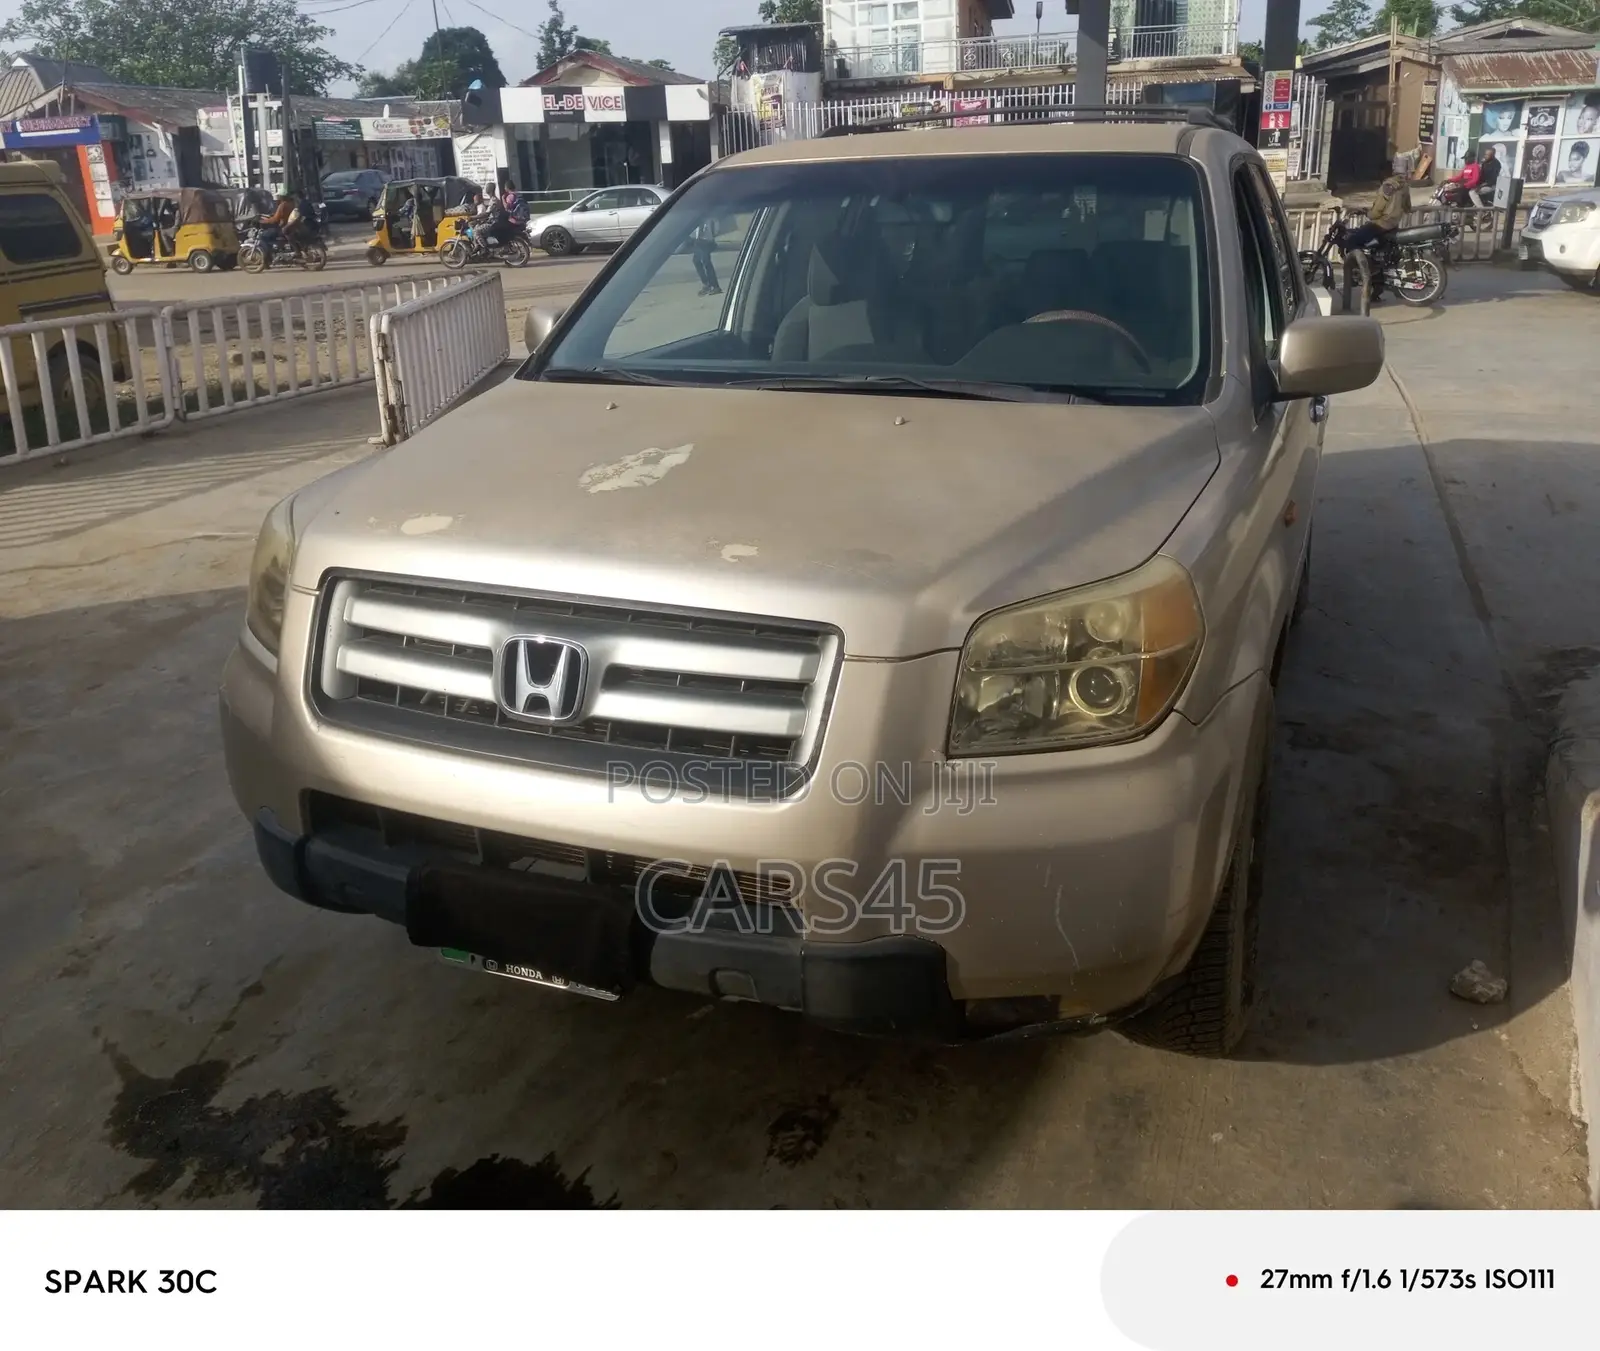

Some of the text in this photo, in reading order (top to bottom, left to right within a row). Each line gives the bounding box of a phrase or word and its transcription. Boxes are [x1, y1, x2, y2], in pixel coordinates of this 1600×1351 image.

[543, 94, 624, 111] EL-DE VICE
[505, 964, 543, 980] HONDA
